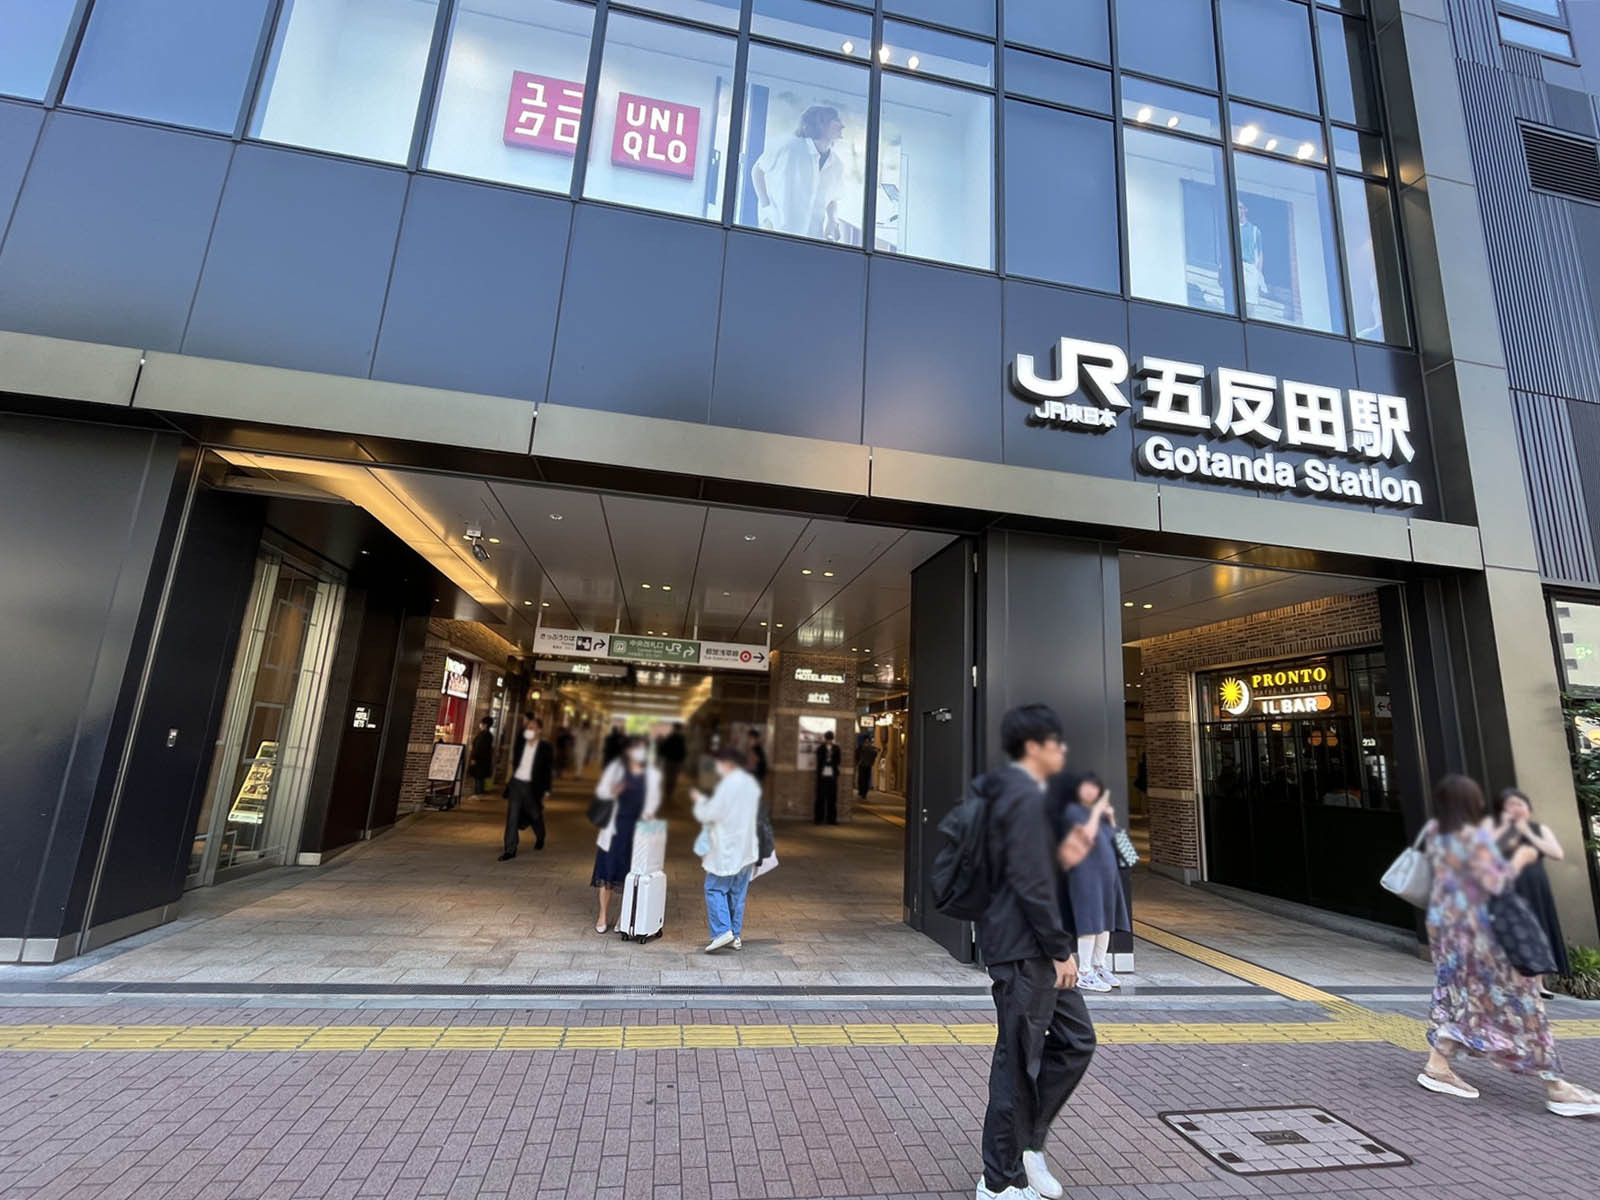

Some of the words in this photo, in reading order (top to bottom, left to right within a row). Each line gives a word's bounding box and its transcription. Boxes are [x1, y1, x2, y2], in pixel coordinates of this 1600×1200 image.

[626, 102, 685, 136] UNI
[622, 131, 687, 163] QLO
[1016, 336, 1132, 408] JR
[1034, 400, 1118, 428] JR東日本
[1138, 355, 1416, 464] 五反田駅
[1143, 435, 1297, 489] Gotanda
[1303, 459, 1423, 506] Station
[1251, 666, 1327, 689] PRONTO
